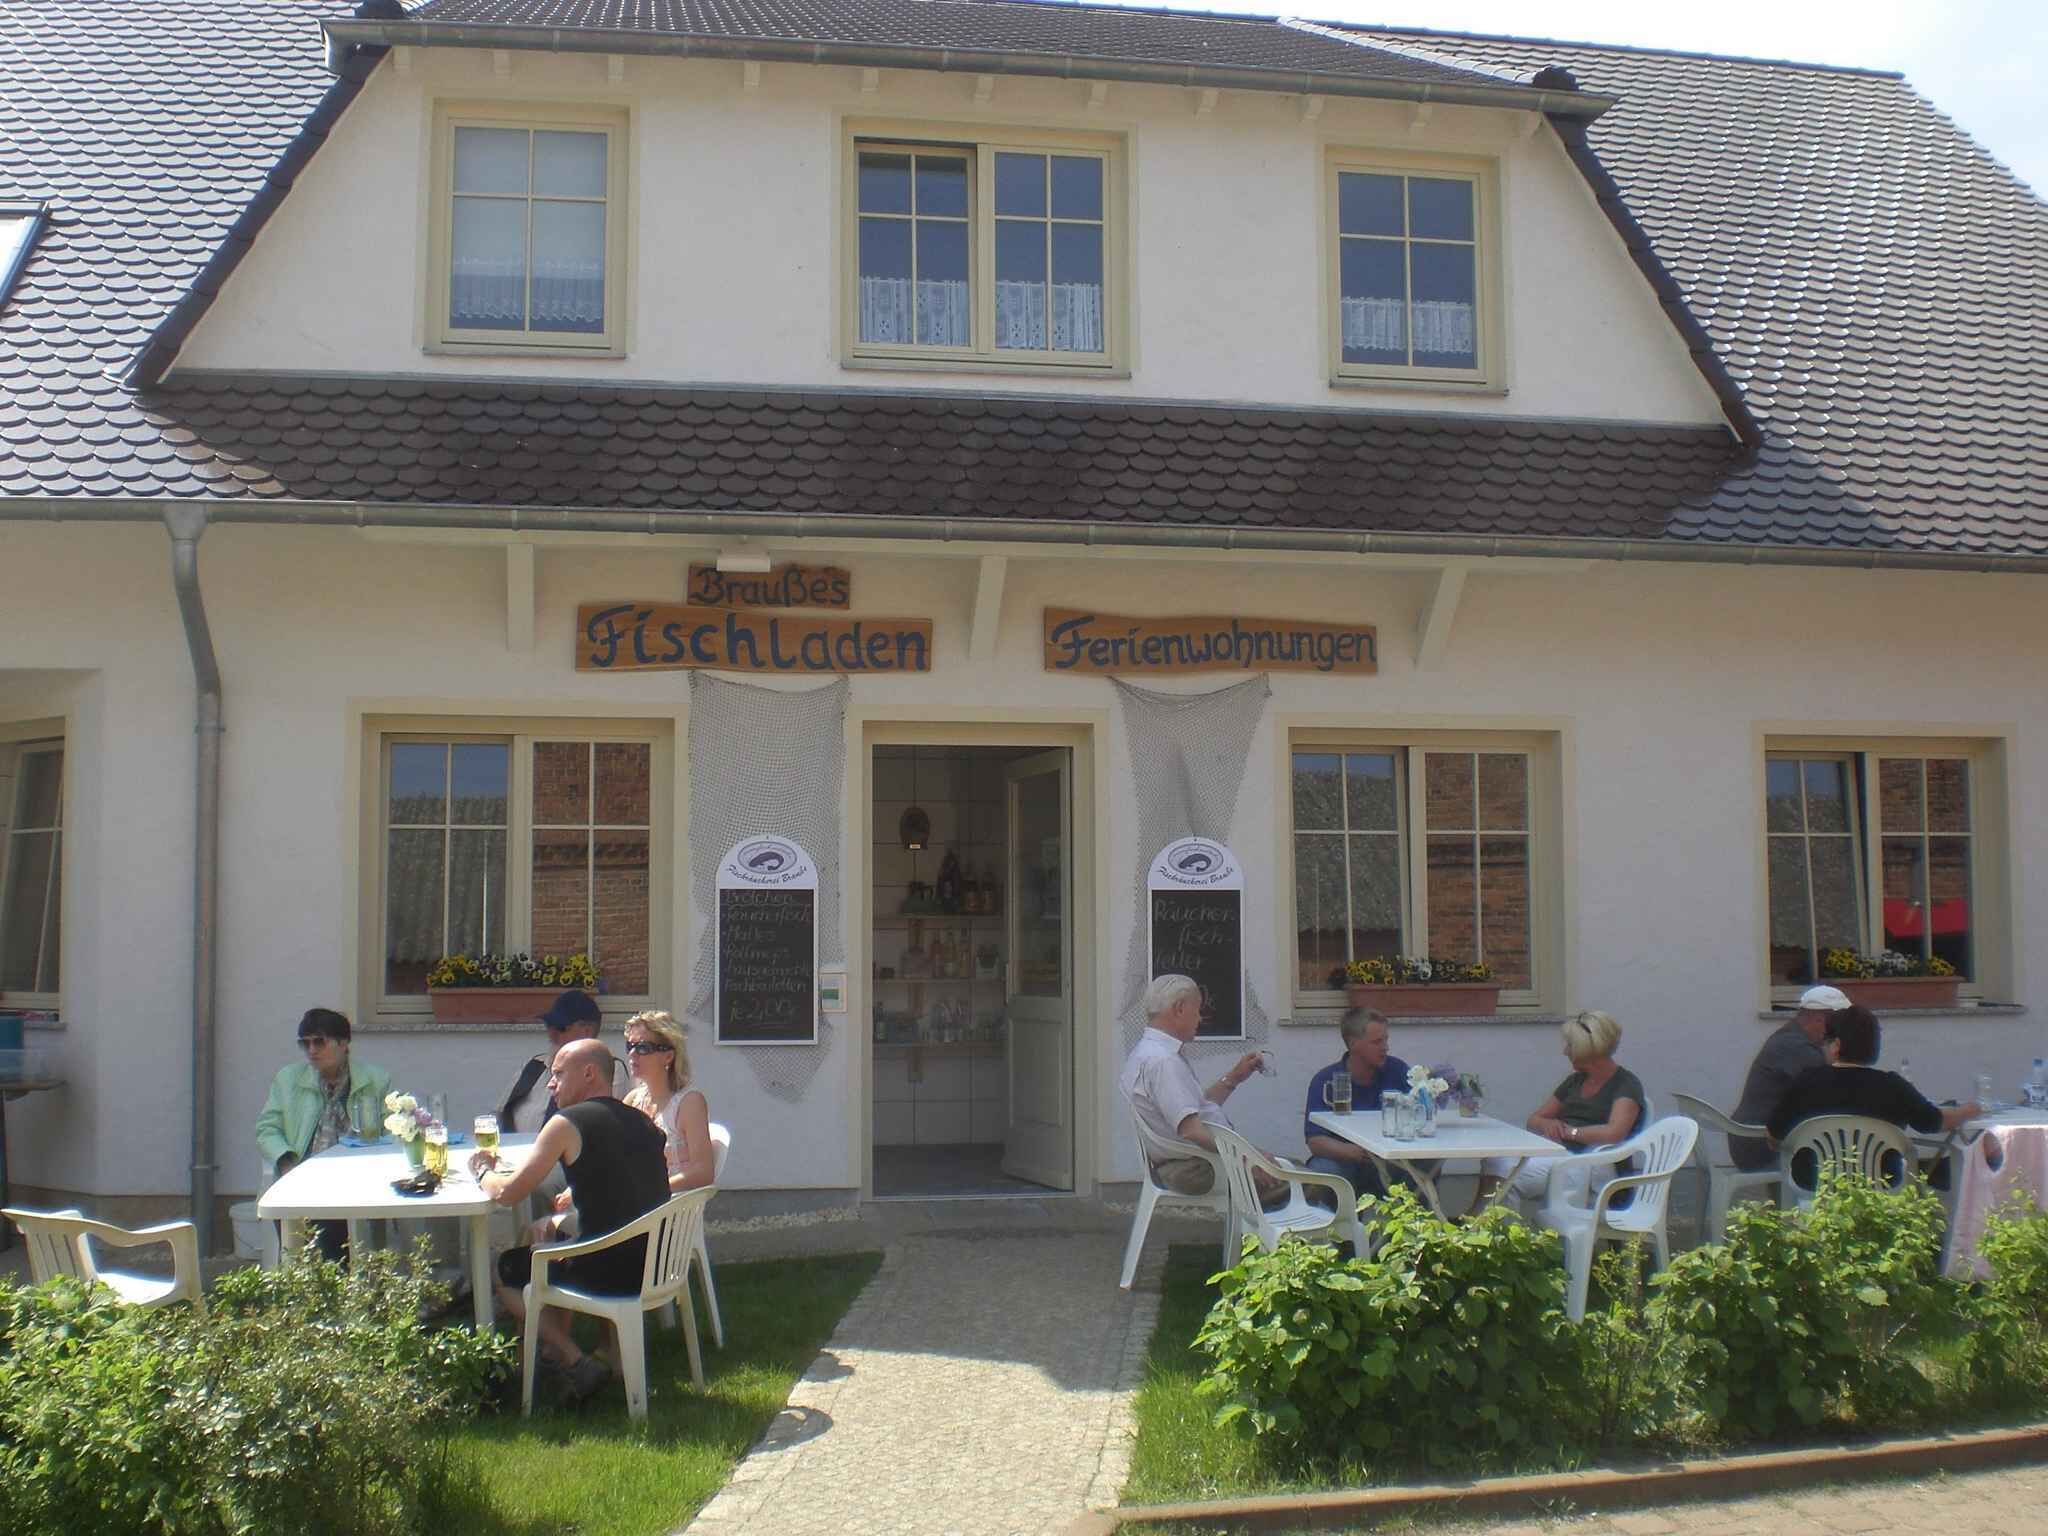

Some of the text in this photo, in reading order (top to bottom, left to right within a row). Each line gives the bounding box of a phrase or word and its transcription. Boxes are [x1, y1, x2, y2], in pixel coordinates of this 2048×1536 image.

[691, 566, 849, 607] Braußes
[587, 604, 927, 671] Fischladen
[1051, 615, 1377, 672] Ferienwohnungen
